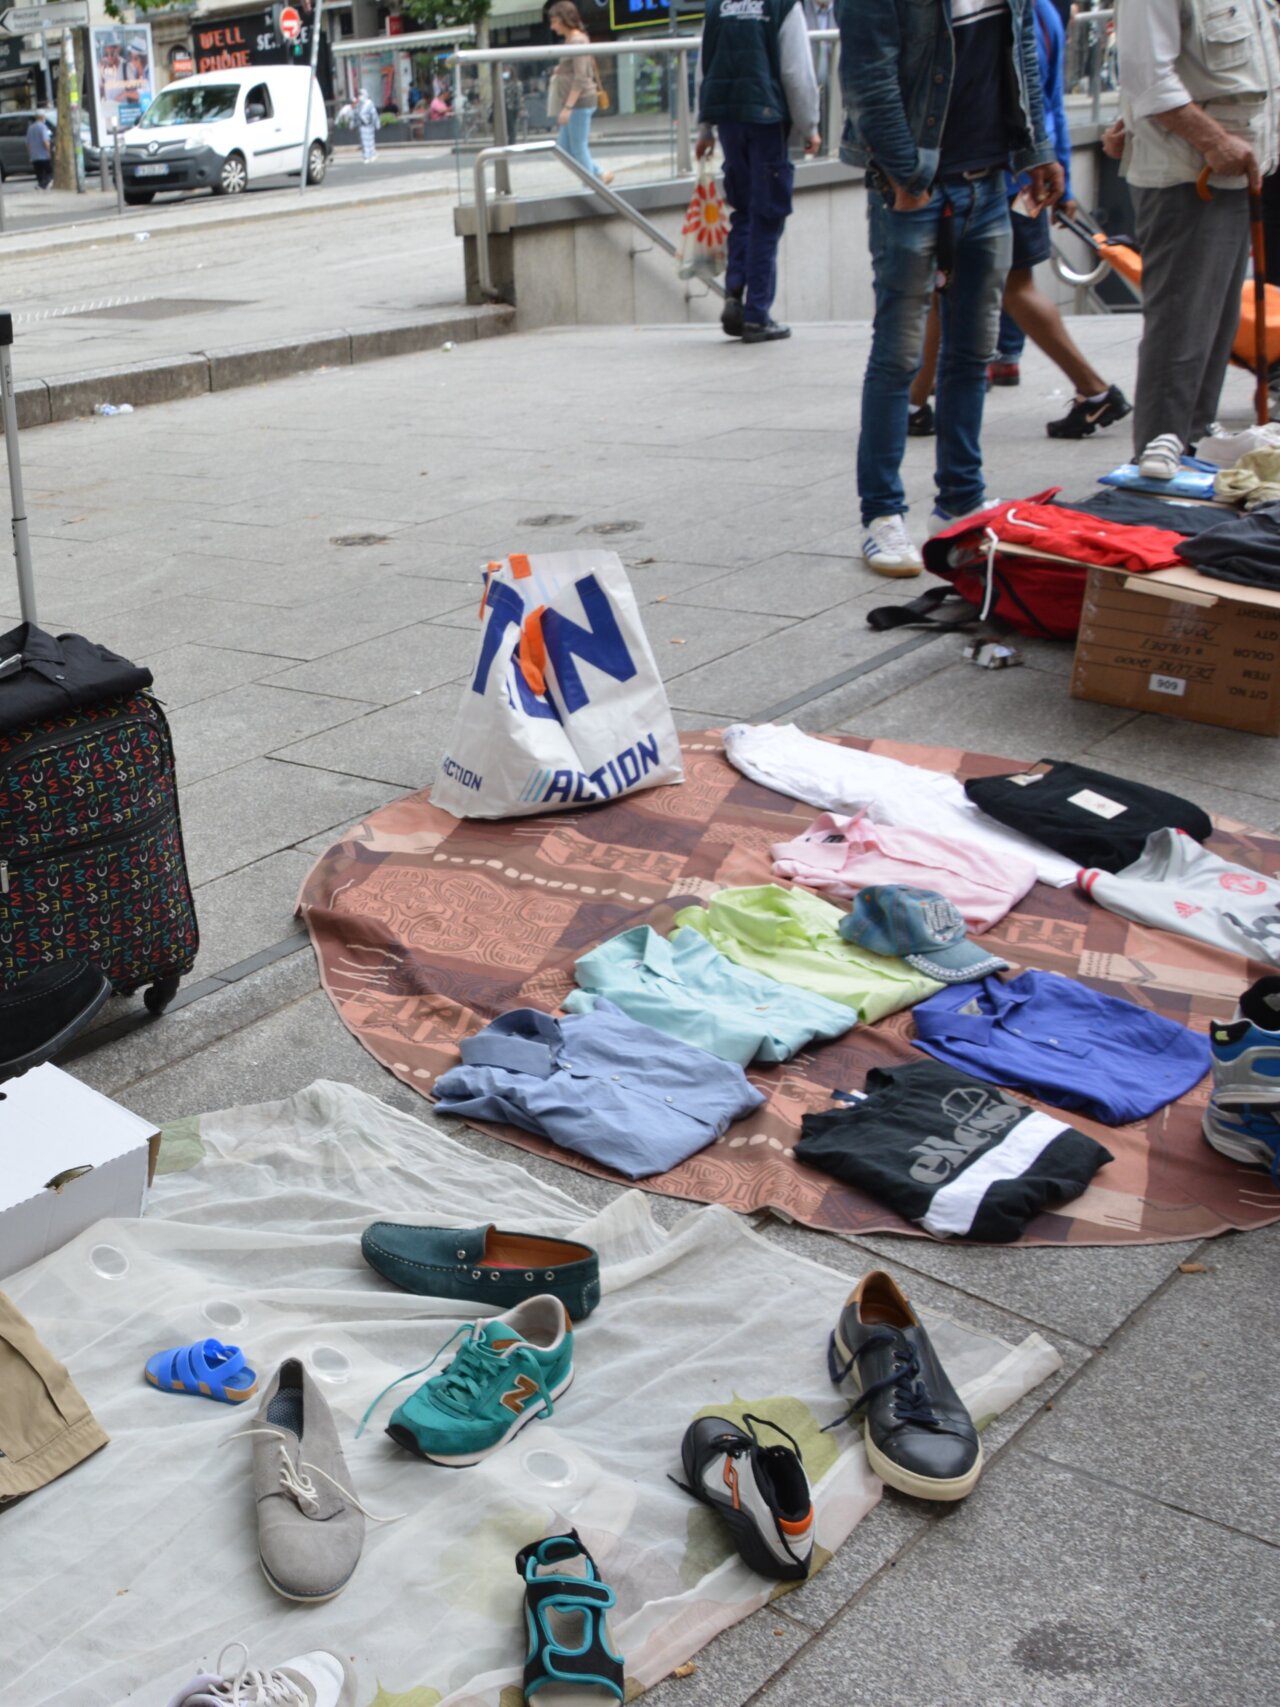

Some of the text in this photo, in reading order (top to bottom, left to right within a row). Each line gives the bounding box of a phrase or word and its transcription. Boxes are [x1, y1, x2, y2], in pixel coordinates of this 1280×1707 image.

[200, 26, 246, 49] WELL
[199, 50, 251, 74] PHONE
[1233, 648, 1275, 661] COLOR
[1242, 668, 1272, 681] ITEM
[543, 733, 661, 802] ACTION
